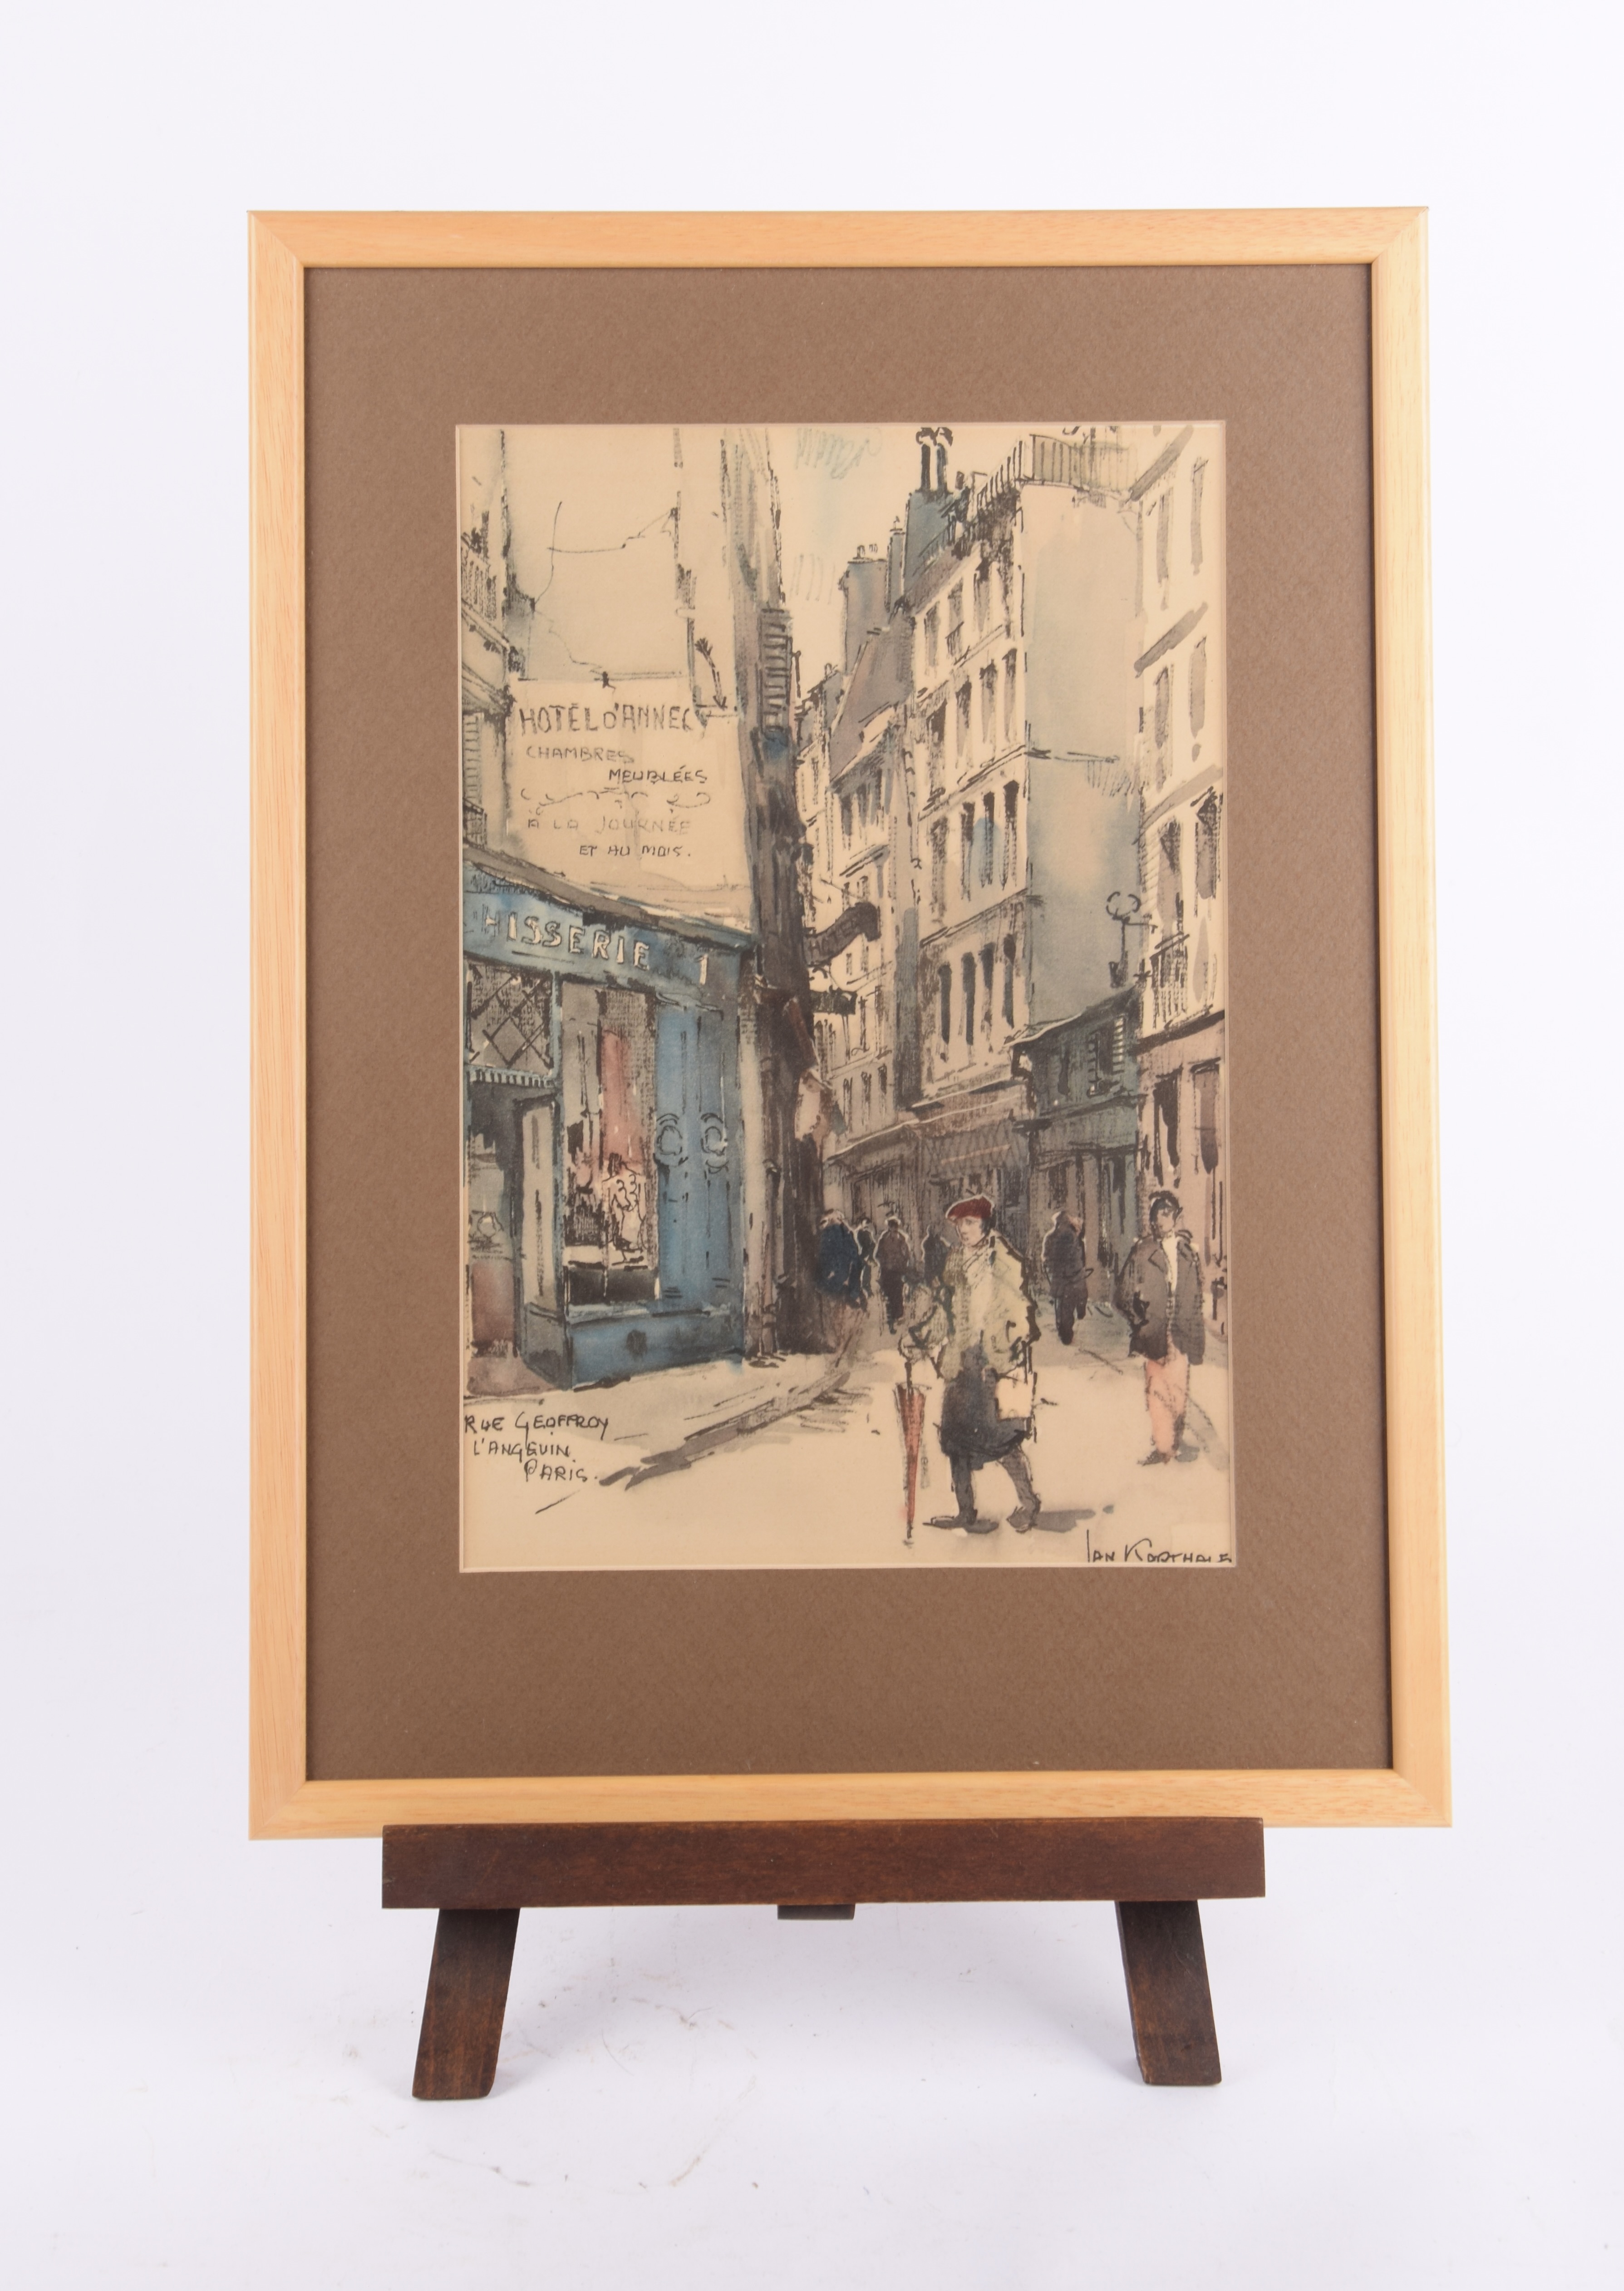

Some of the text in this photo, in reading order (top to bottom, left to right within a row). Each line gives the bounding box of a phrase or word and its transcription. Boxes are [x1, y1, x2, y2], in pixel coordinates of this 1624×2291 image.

[526, 745, 634, 763] CHAMBRES
[553, 819, 578, 830] LA
[580, 844, 597, 856] ET
[608, 845, 630, 856] AU
[464, 1415, 504, 1433] RUE
